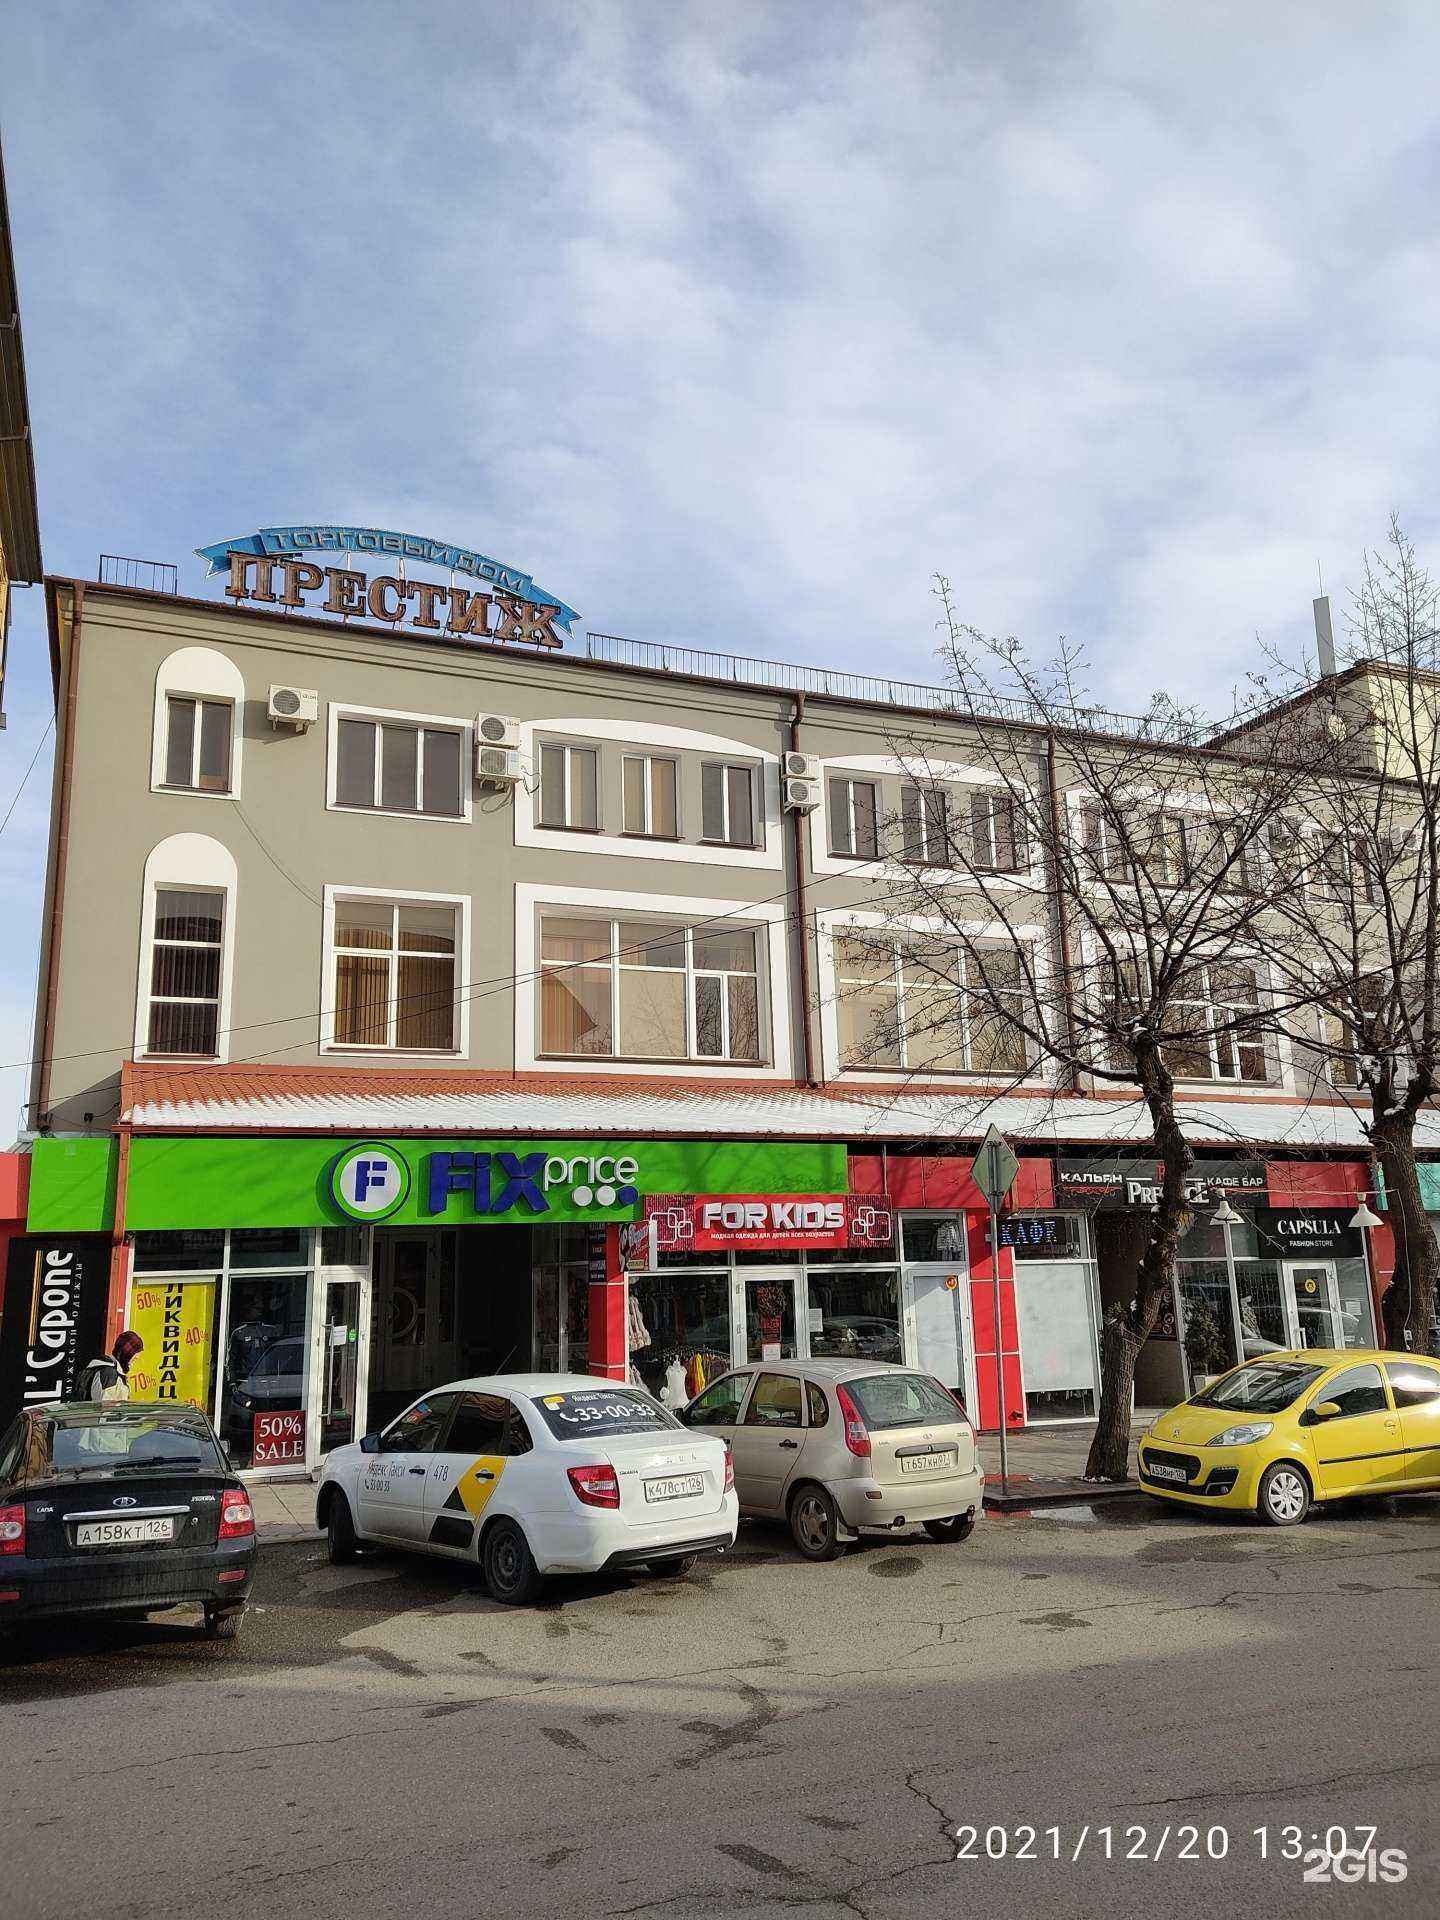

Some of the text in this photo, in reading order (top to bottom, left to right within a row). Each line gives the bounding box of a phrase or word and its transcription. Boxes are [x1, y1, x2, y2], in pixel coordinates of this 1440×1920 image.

[268, 530, 525, 592] ТОРГОВЫЙ ДОМ
[224, 549, 564, 649] ПРЕСТИЖ
[543, 1155, 640, 1192] price
[1060, 1172, 1123, 1183] КАЛЬЯН
[1206, 1176, 1264, 1187] КАФЕ БАР
[702, 1202, 845, 1229] FOR KIDS
[1277, 1219, 1342, 1234] CAPSULA
[136, 1291, 161, 1310] 50%
[185, 1326, 209, 1345] 40%
[130, 1372, 157, 1392] 70%
[574, 1403, 656, 1421] 33-00-33
[259, 1415, 302, 1438] 50%
[255, 1440, 305, 1461] SALE
[433, 1464, 449, 1481] 478
